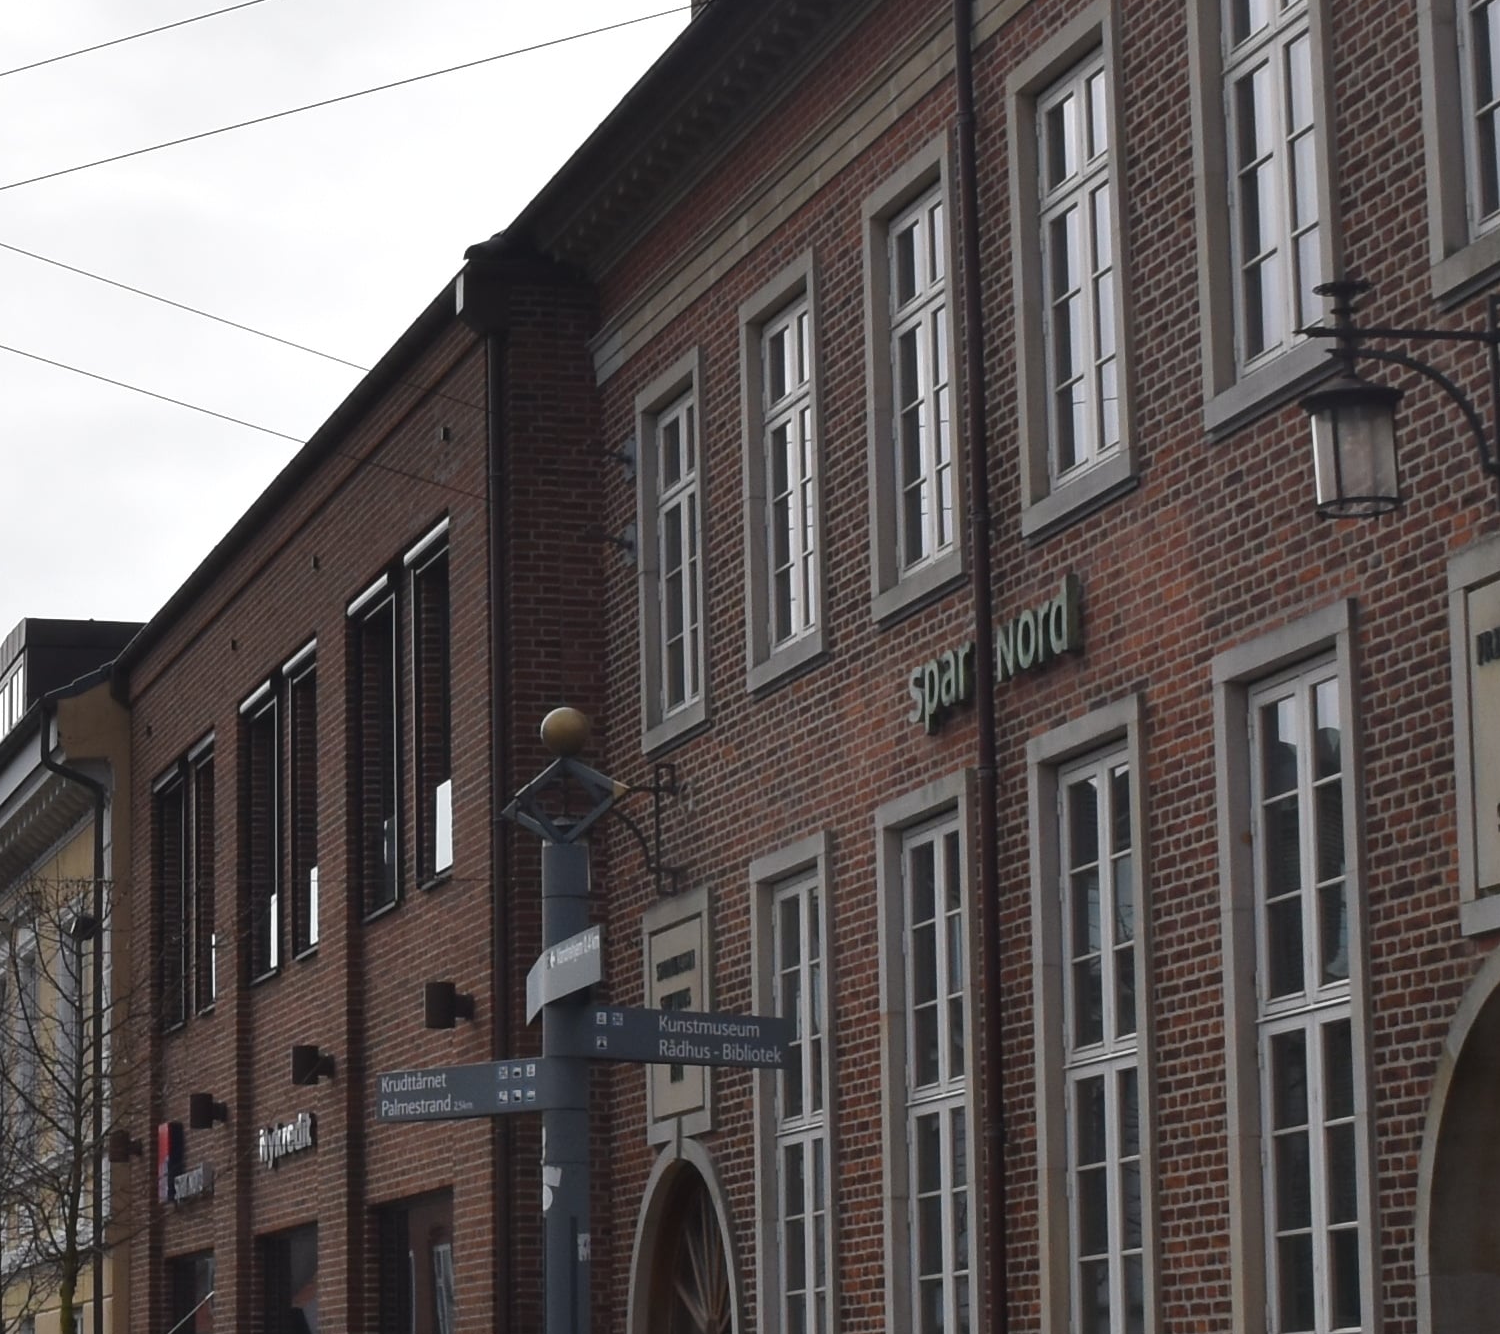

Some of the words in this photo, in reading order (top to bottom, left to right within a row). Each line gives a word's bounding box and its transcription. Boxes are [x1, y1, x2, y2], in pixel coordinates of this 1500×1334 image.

[909, 641, 974, 735] spar
[996, 573, 1069, 683] Nord
[658, 1014, 760, 1038] Kunstmuseum
[658, 1038, 711, 1059] Rådhus
[722, 1043, 782, 1063] Bibliotek
[381, 1072, 448, 1093] Krudttårnet
[381, 1094, 452, 1117] Palmestrand
[259, 1113, 312, 1170] Nykredit
